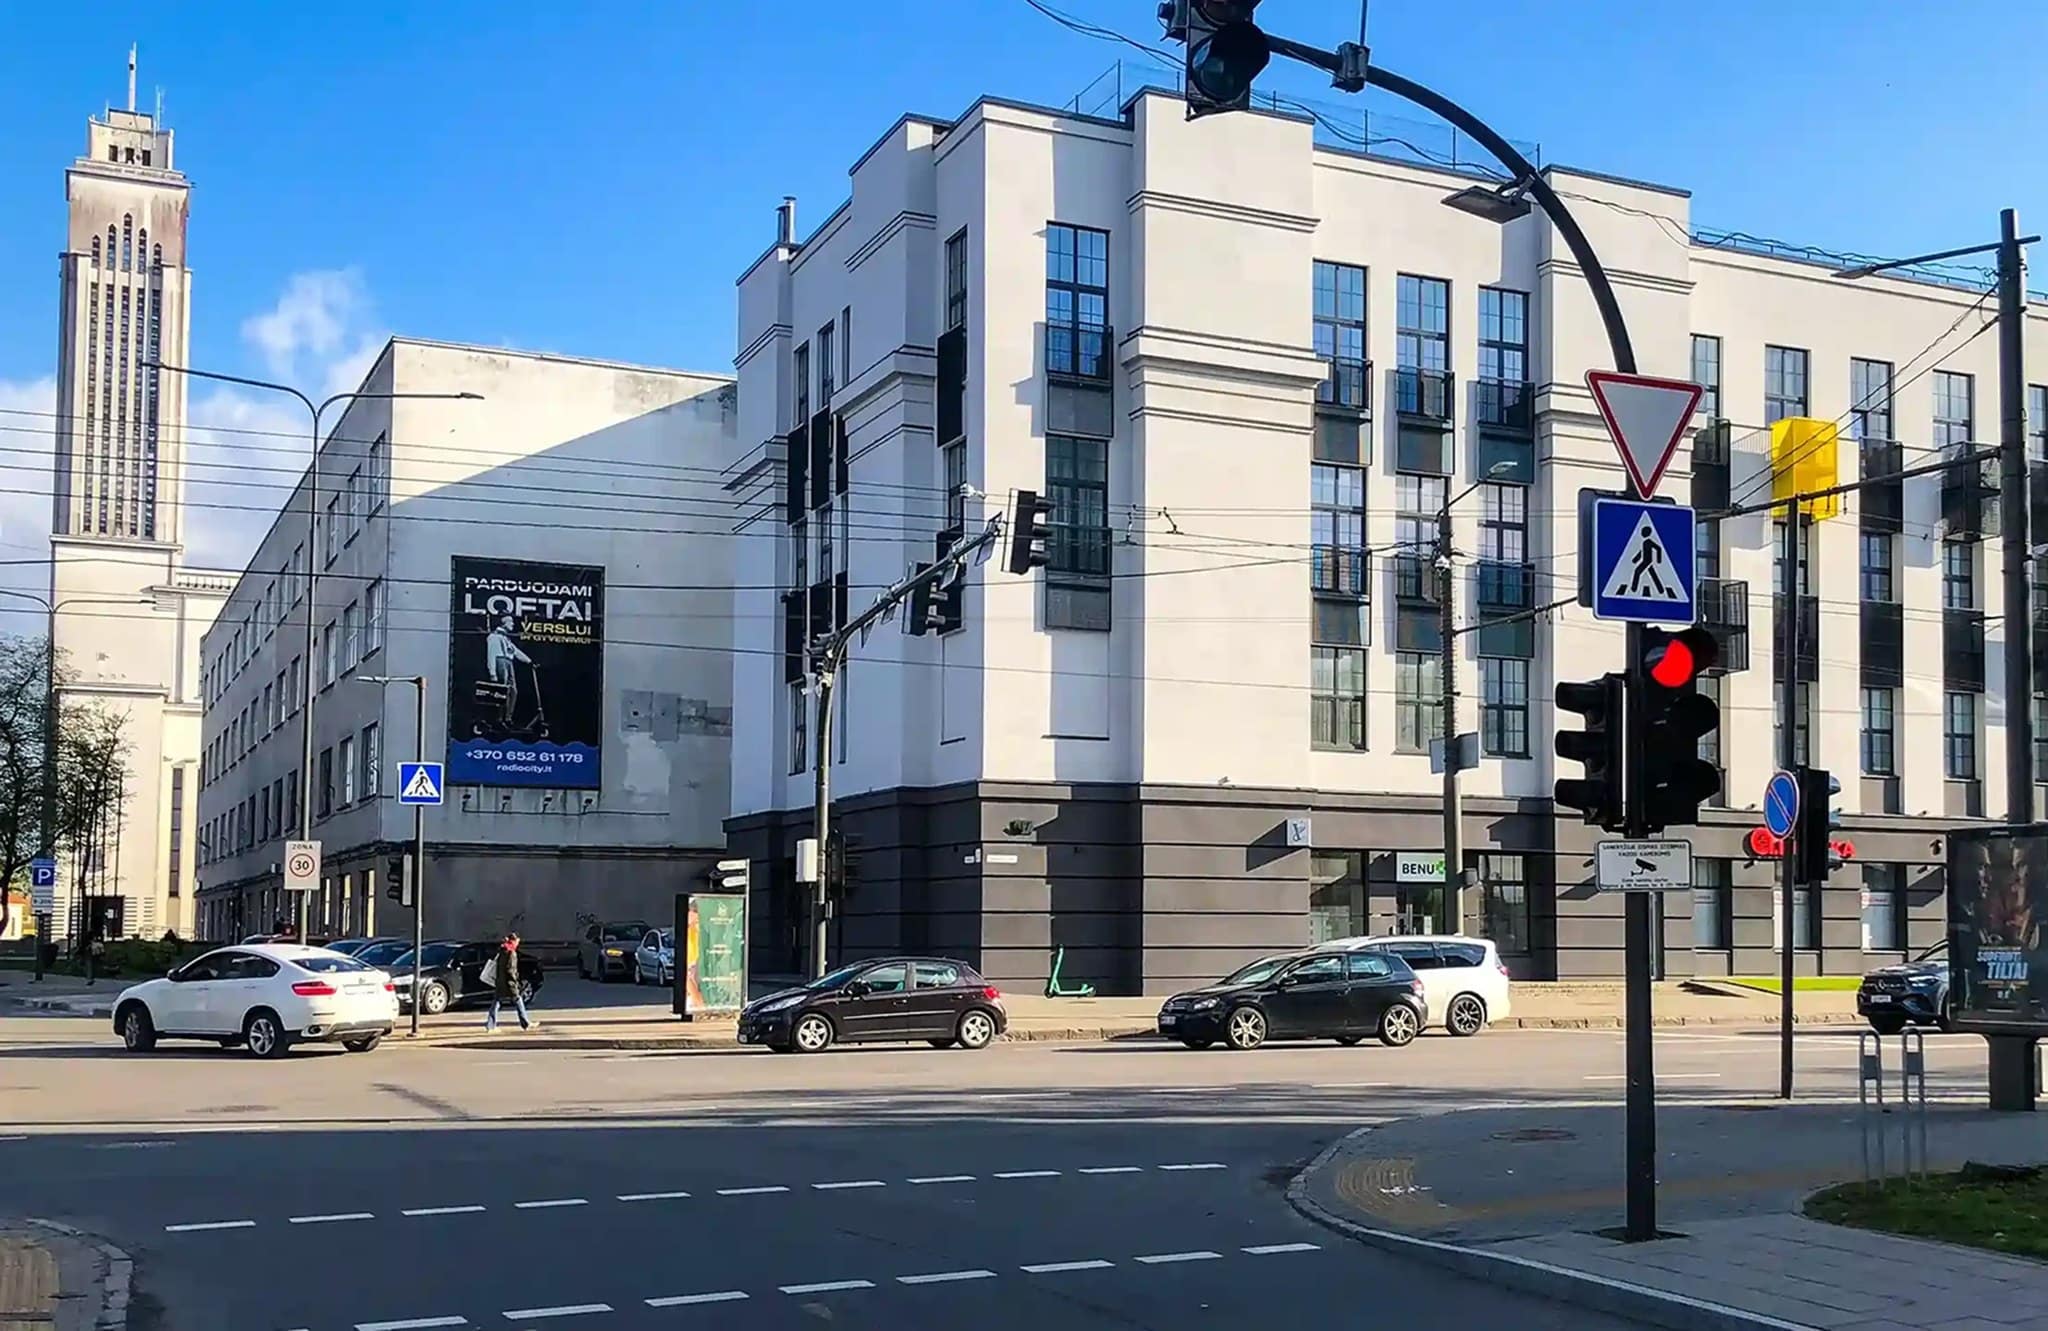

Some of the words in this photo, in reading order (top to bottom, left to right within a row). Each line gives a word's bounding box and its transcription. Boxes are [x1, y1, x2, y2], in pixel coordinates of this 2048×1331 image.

[465, 576, 592, 597] PARDUODAMI
[465, 593, 592, 621] LOFTAI
[521, 622, 591, 635] VERSLUI
[465, 749, 502, 760] +370
[506, 751, 536, 761] 652
[539, 752, 556, 762] 61
[558, 753, 583, 763] 178
[497, 763, 552, 774] radiocity.lt
[295, 861, 309, 870] 30
[1402, 863, 1435, 874] BENU
[38, 869, 51, 884] P
